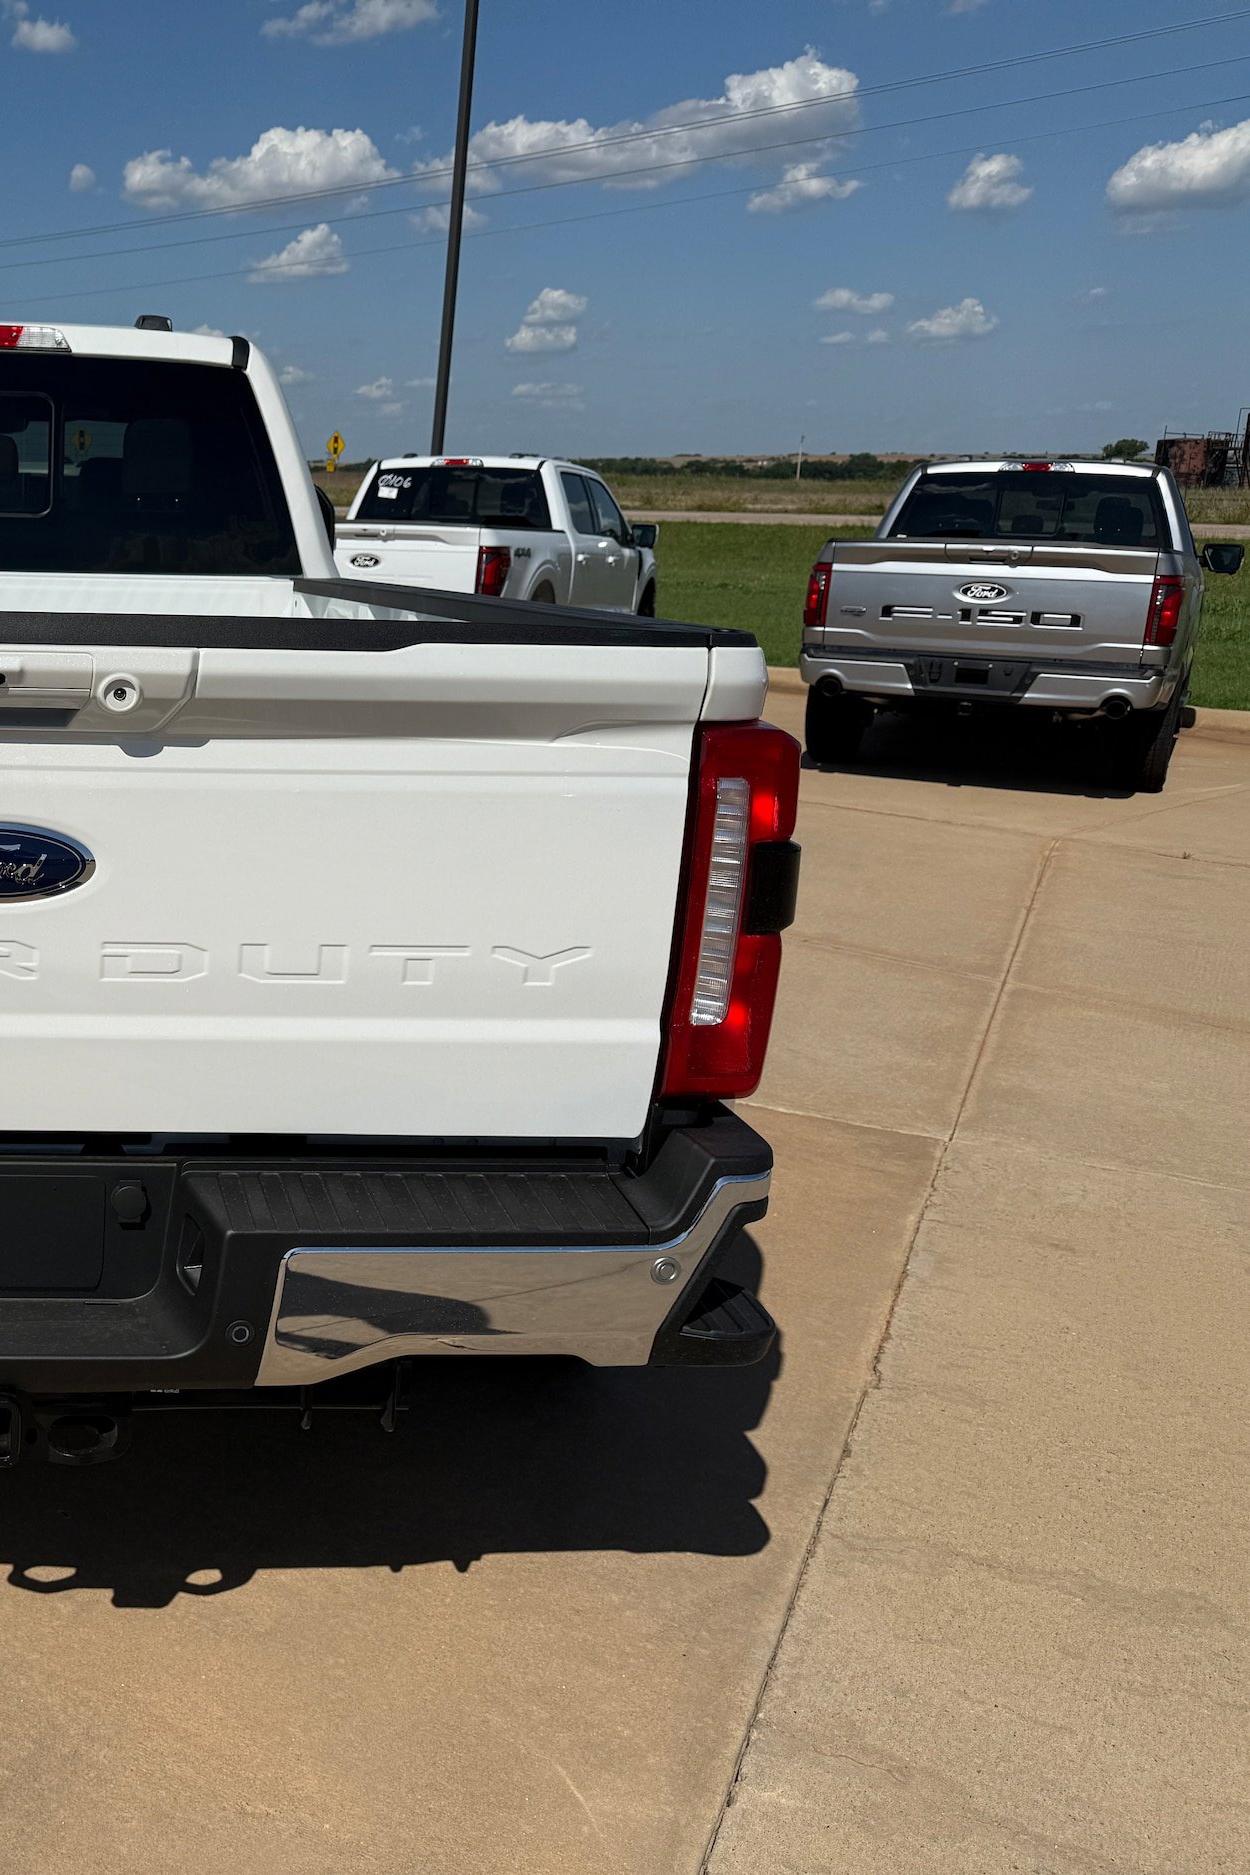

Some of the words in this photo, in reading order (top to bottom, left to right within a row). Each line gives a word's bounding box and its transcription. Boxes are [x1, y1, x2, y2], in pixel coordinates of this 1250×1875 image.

[967, 584, 998, 599] Ford
[878, 604, 1085, 631] F-150
[101, 941, 593, 986] DUTY
